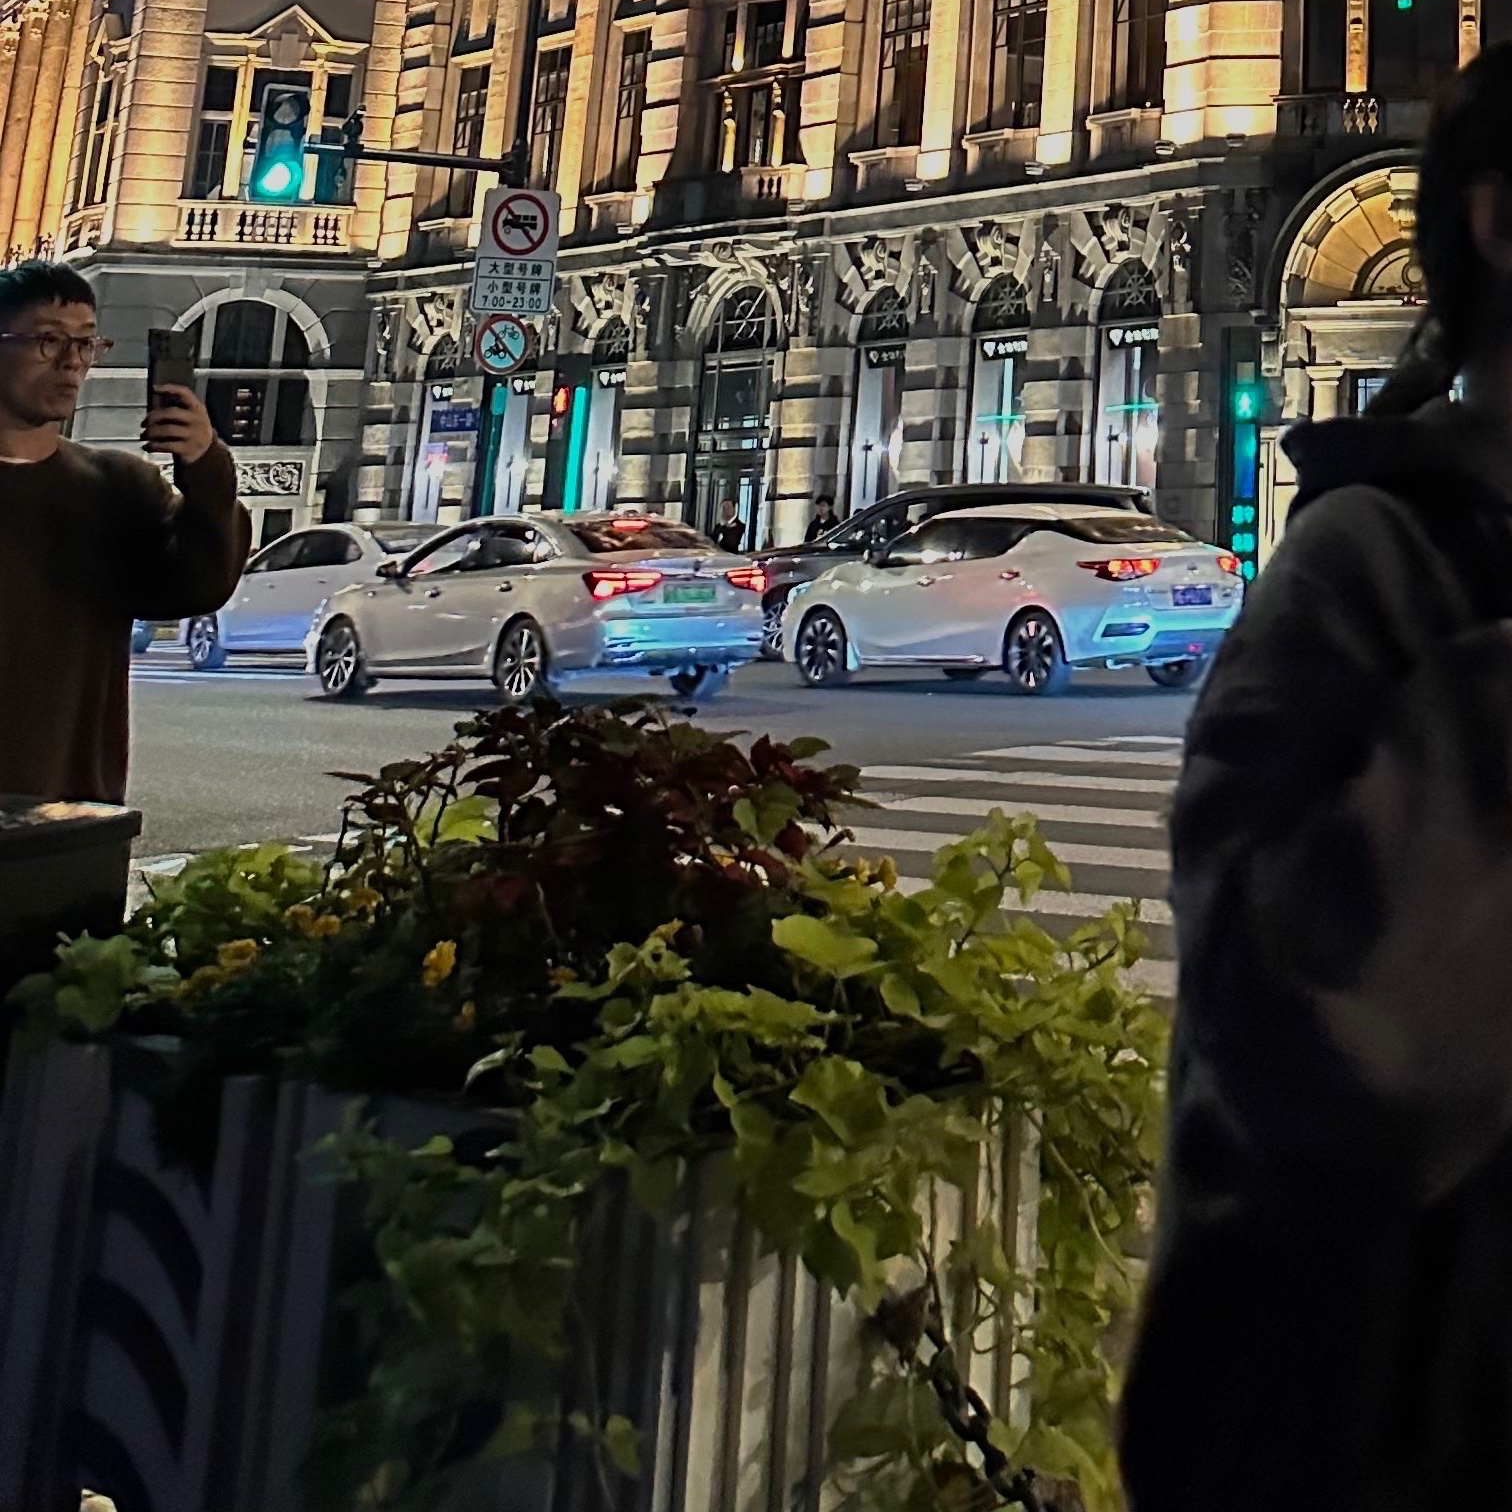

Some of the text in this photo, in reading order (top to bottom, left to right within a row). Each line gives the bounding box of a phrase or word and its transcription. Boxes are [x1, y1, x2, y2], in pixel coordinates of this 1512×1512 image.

[488, 261, 542, 276] 大型号牌
[486, 280, 541, 295] 小型号牌
